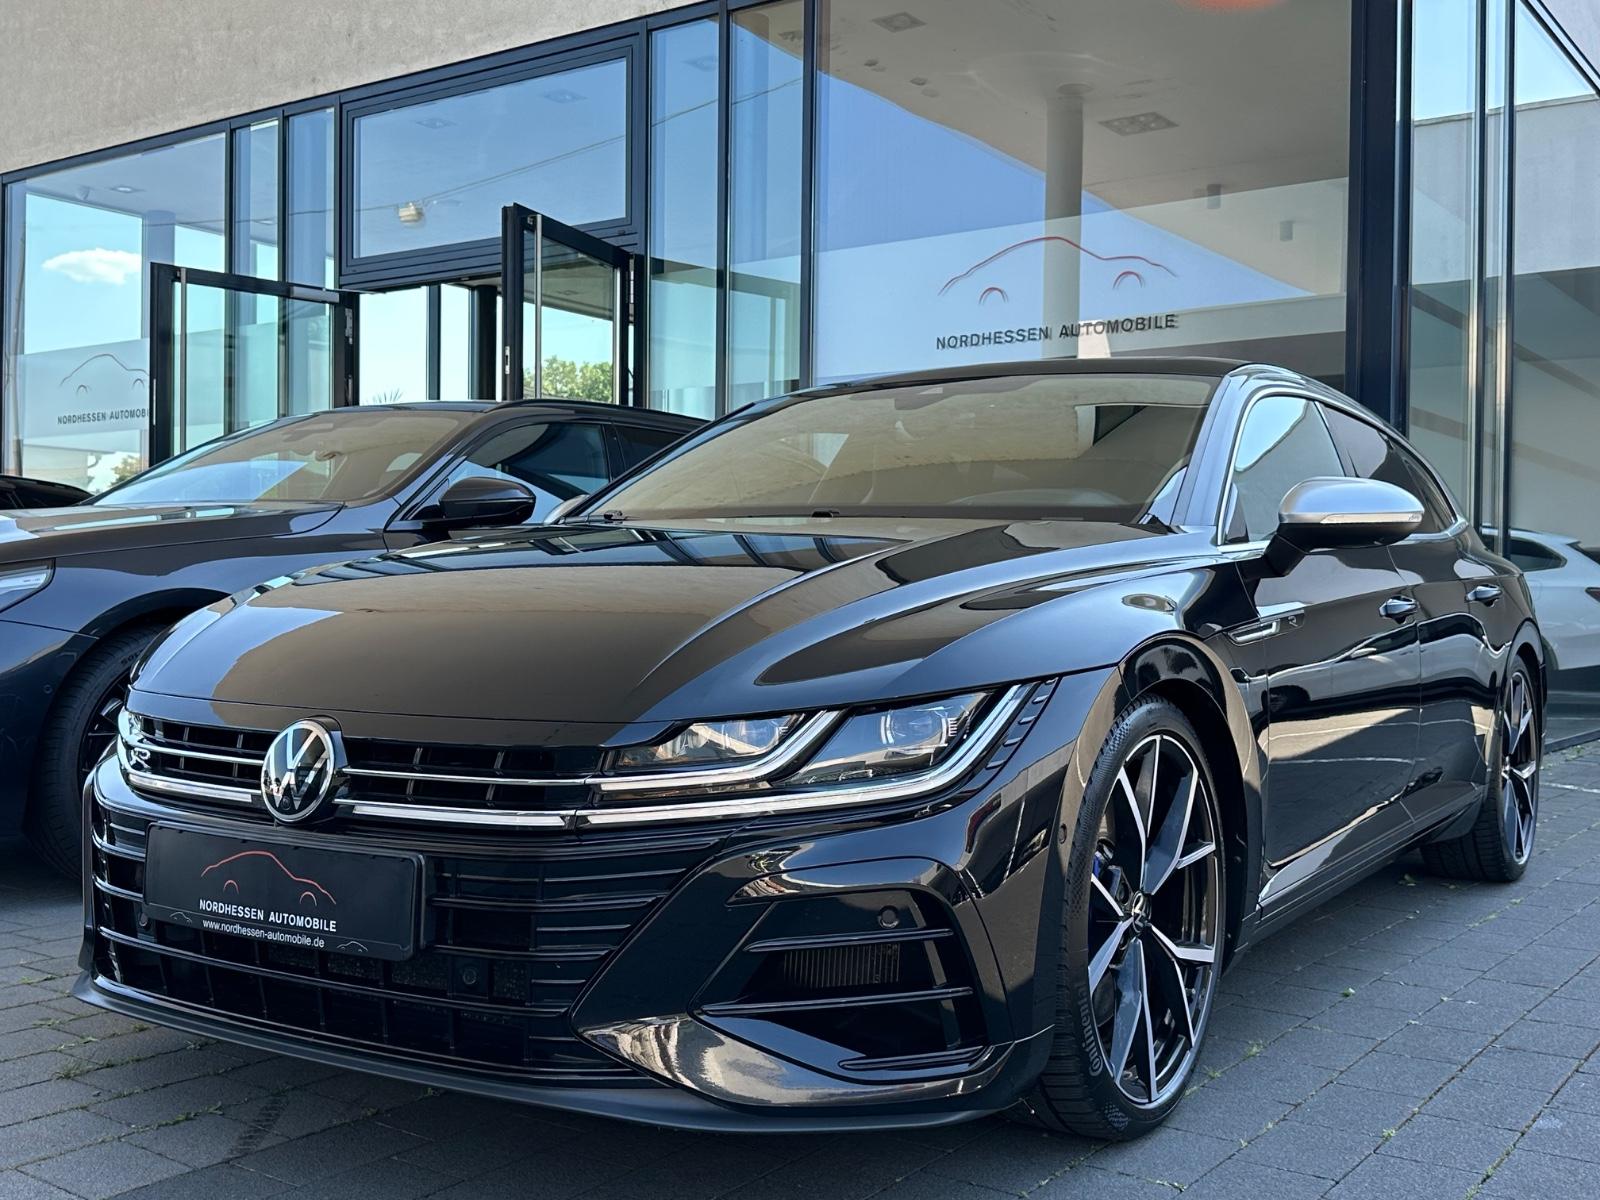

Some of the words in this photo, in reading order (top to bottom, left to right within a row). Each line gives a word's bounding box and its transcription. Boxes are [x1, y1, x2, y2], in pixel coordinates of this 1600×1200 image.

[936, 326, 1052, 350] NORDHESSEN
[1059, 313, 1178, 339] AUTOMOBILE
[57, 412, 107, 424] NORDHESSEN
[109, 408, 149, 420] AUTOMOBI
[199, 899, 264, 921] NORDHESSEN
[268, 911, 337, 932] AUTOMOBILE
[202, 919, 325, 948] www.nordhessen-automobile.de
